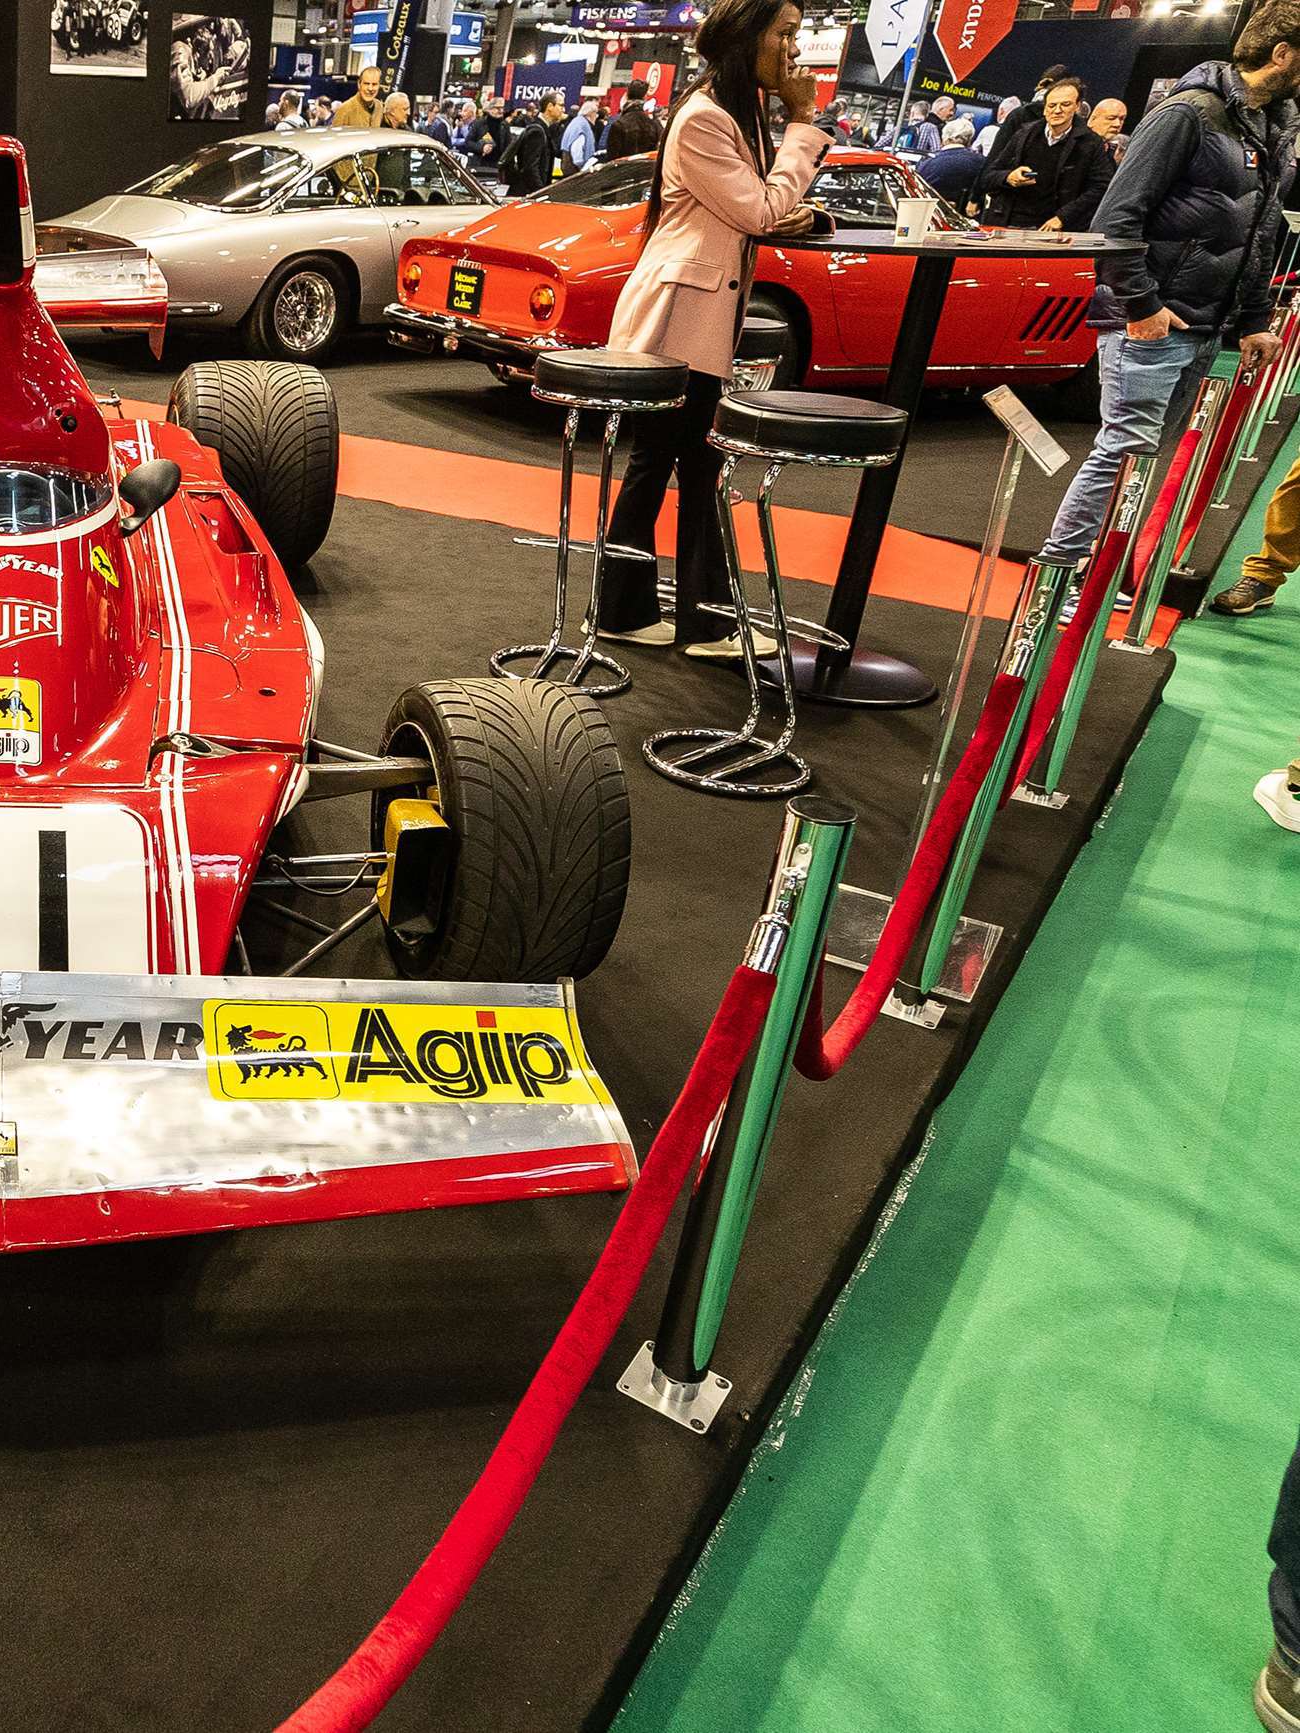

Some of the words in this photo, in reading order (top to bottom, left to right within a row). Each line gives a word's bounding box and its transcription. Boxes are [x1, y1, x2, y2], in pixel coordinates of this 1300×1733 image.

[386, 2, 411, 60] Coteaux
[579, 7, 637, 20] FISKENS
[920, 77, 940, 91] Joe
[943, 82, 976, 98] Macari
[23, 1020, 206, 1061] YEAR
[344, 1008, 573, 1099] Agip
